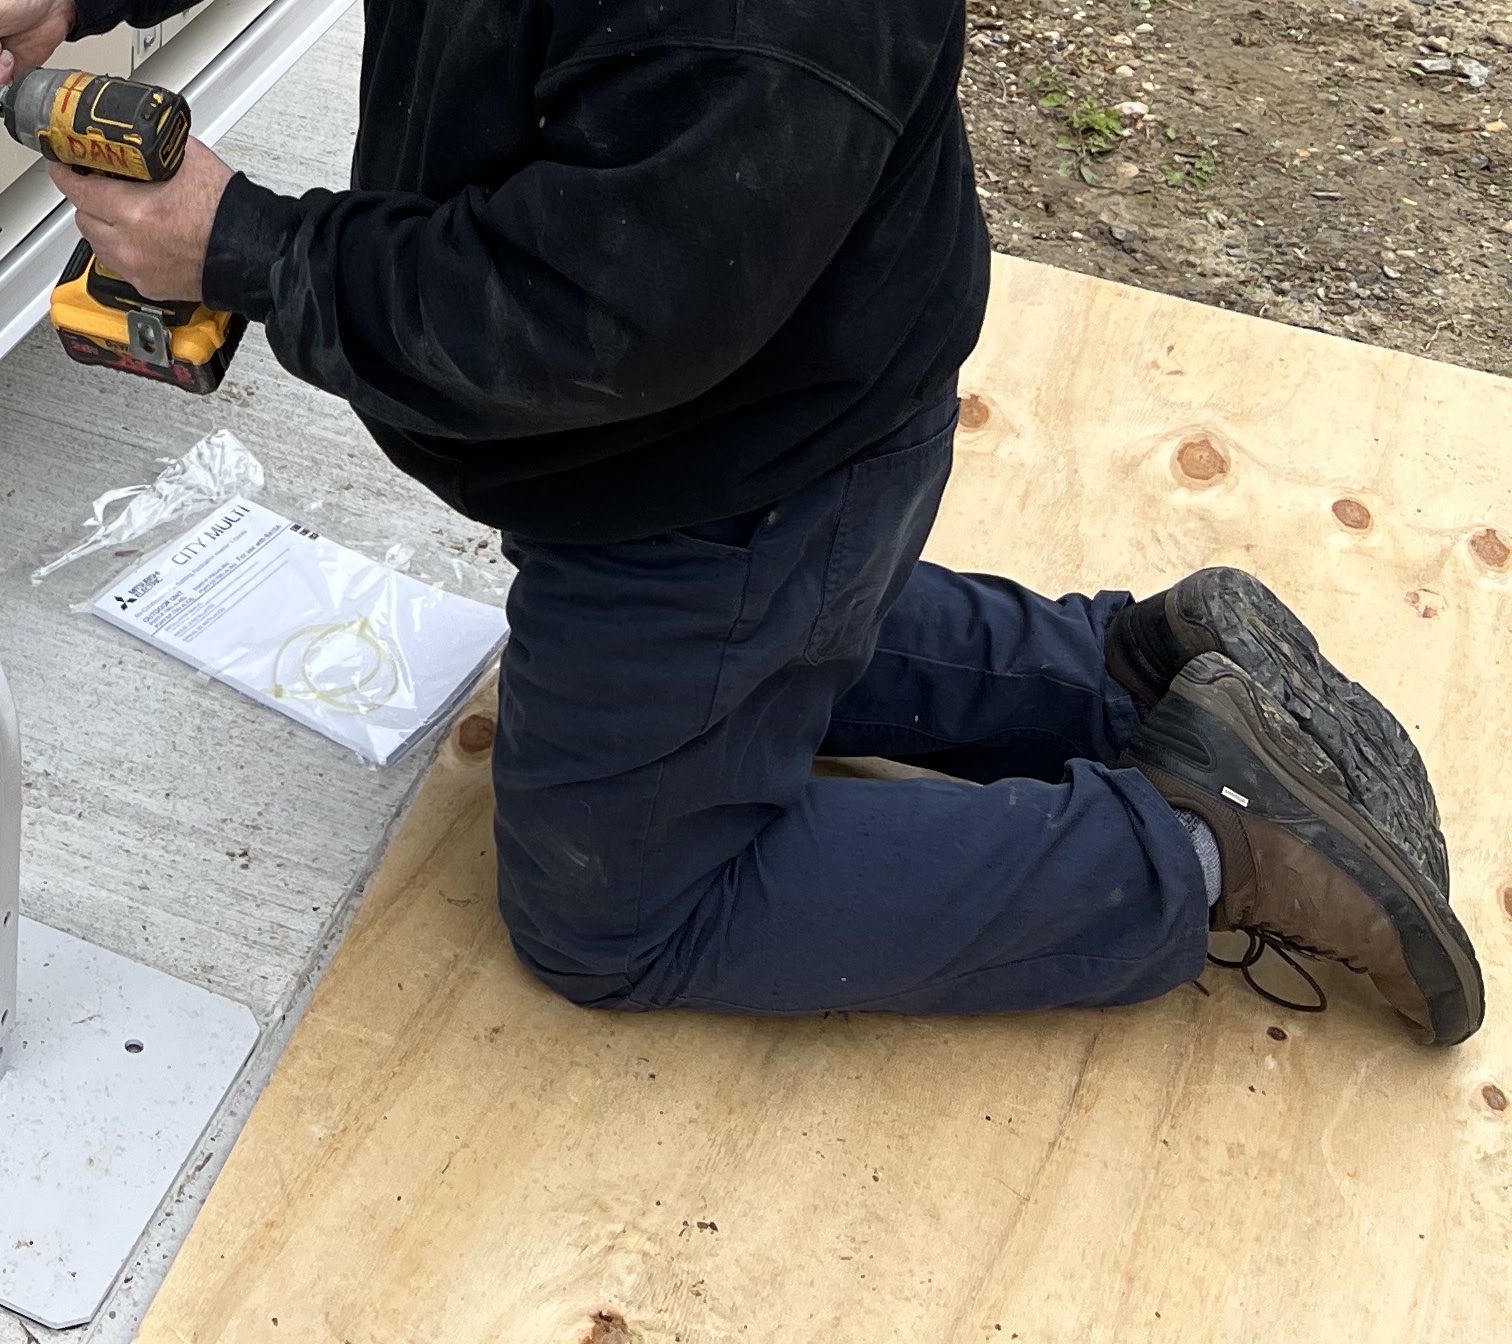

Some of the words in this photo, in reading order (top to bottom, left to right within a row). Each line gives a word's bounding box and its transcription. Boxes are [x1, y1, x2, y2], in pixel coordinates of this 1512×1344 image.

[67, 135, 129, 170] DAN
[171, 537, 207, 565] CITY
[203, 505, 251, 541] MULTI
